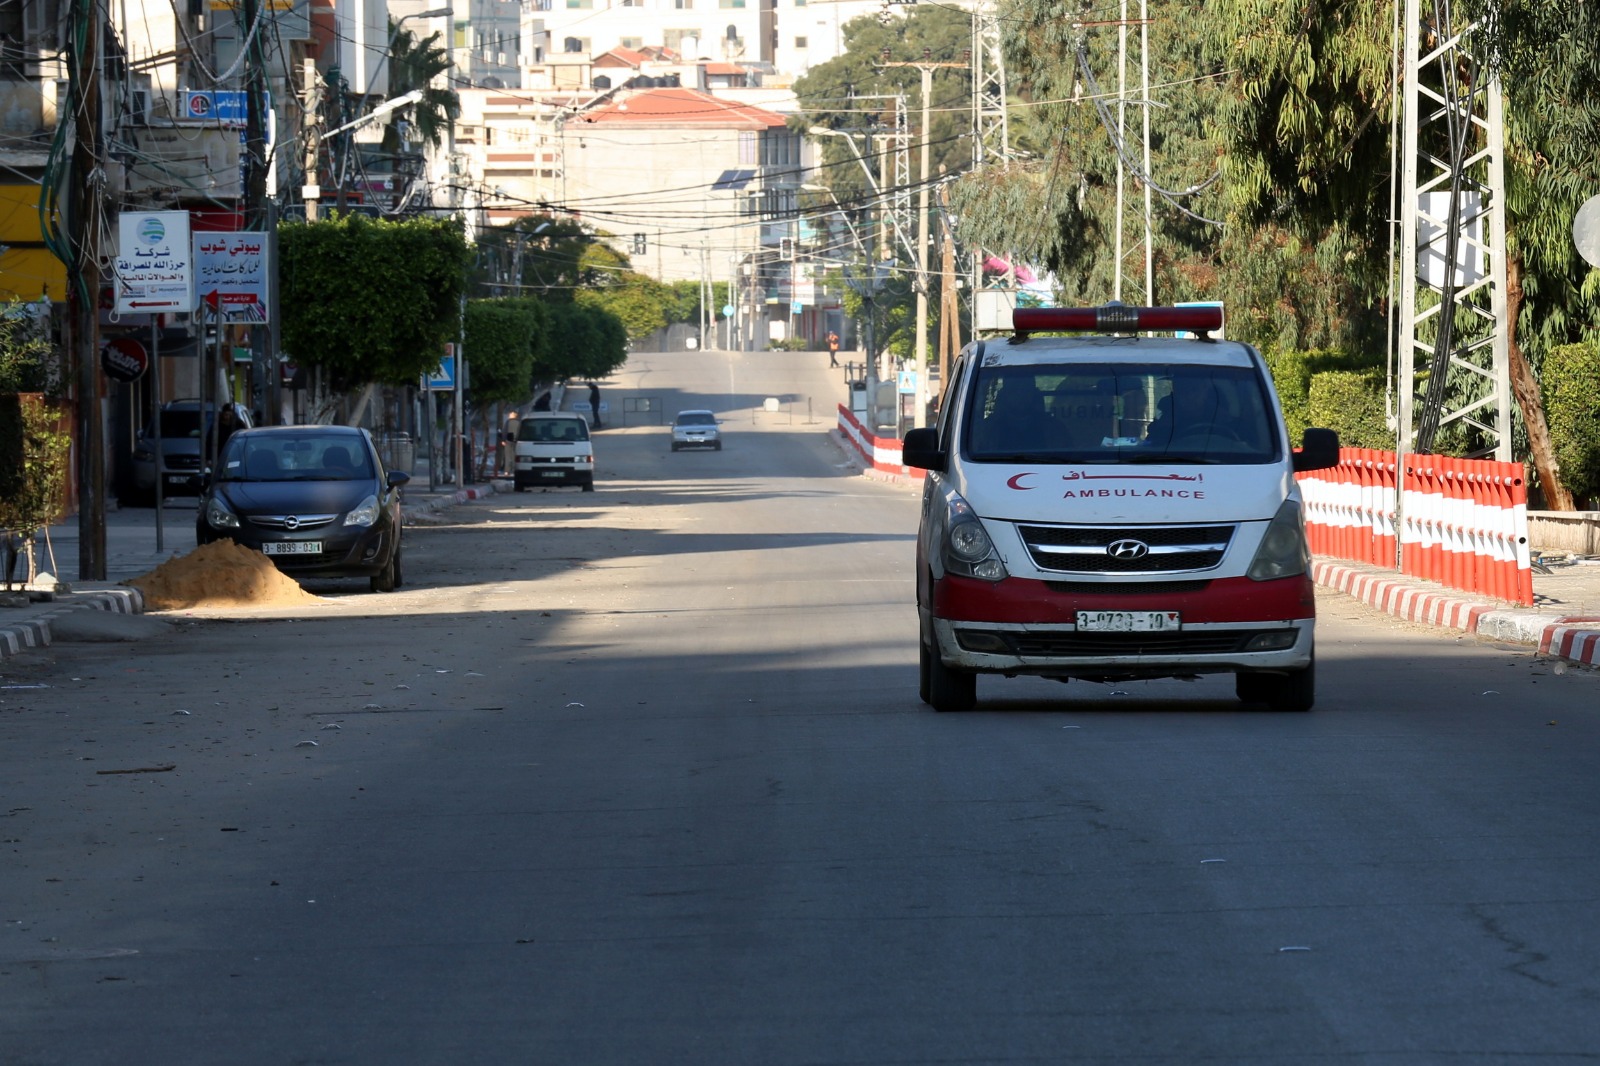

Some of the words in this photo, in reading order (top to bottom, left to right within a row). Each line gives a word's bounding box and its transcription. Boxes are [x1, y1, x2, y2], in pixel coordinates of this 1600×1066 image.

[134, 246, 170, 259] شركة
[200, 239, 226, 254] شوب
[229, 239, 260, 256] بيوتي
[118, 260, 151, 271] للصرافة
[202, 260, 226, 276] العالمية
[222, 258, 260, 274] للماركات
[120, 273, 146, 283] المالية
[148, 273, 183, 281] والحوالات
[1062, 470, 1203, 484] إسعاف
[1063, 489, 1204, 499] AMBULANCE
